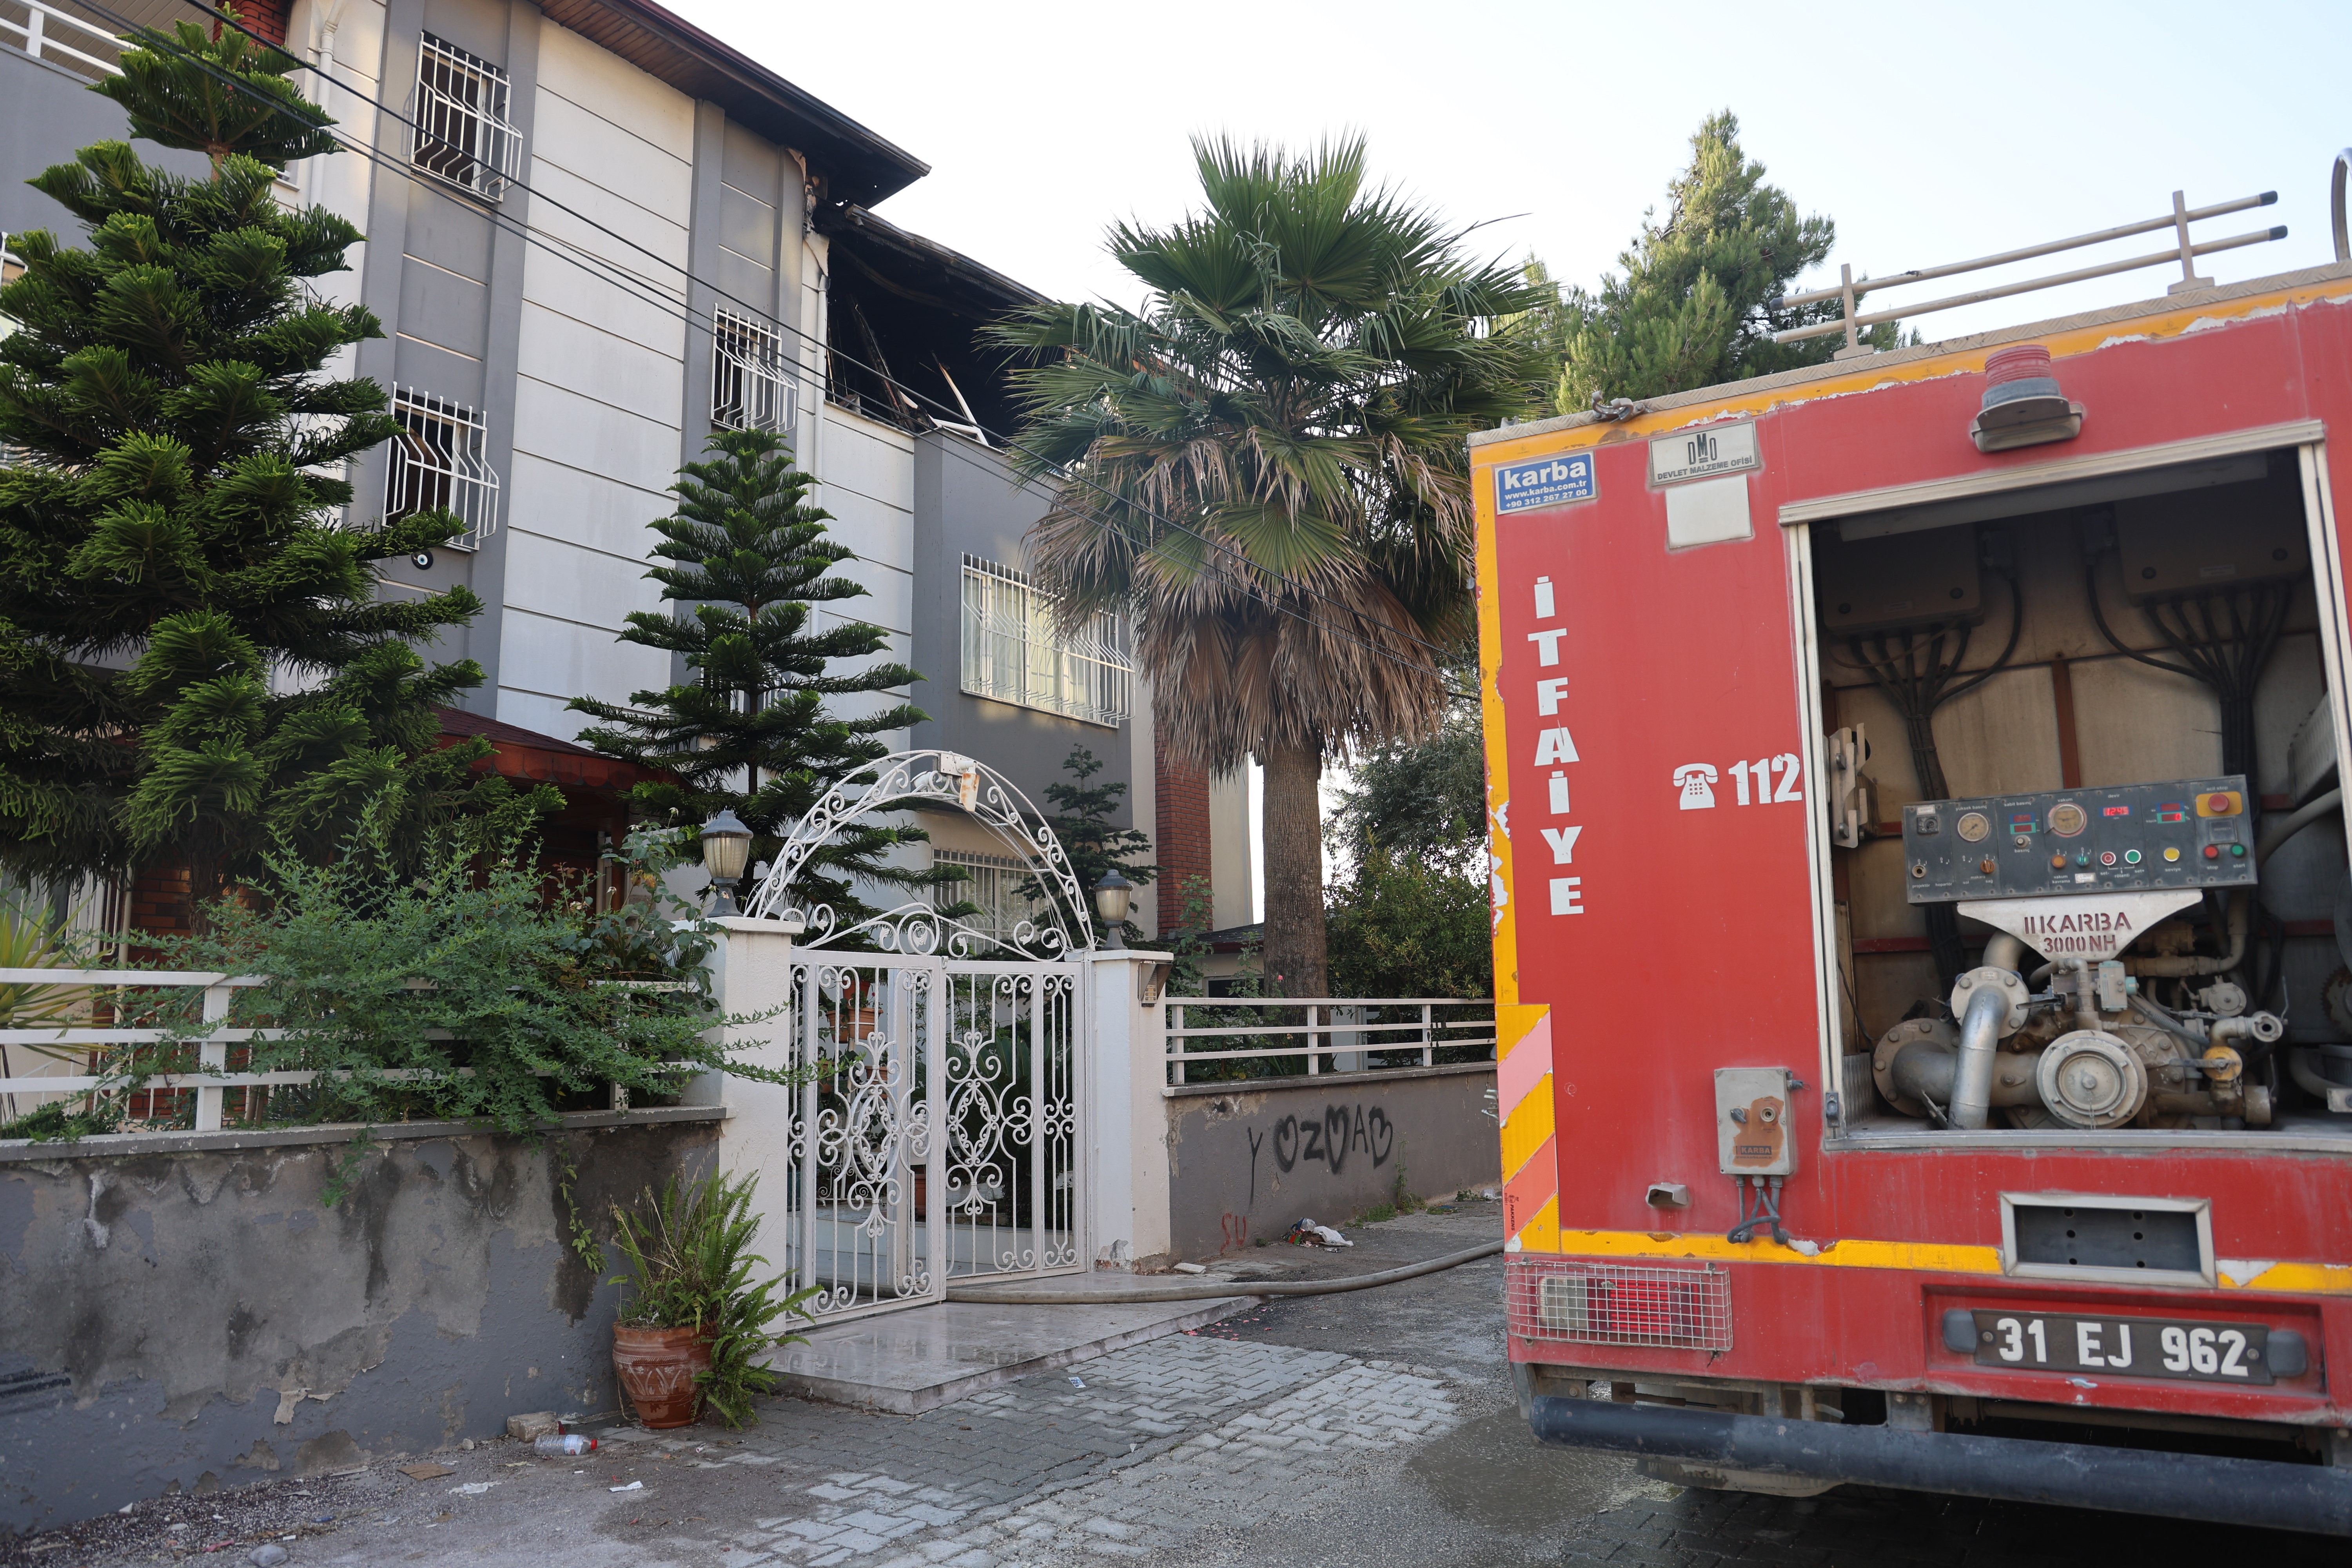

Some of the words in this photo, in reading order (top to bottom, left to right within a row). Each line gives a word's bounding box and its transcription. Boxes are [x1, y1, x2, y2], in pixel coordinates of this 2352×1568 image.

[1688, 433, 1717, 465] DMO
[1504, 461, 1586, 490] karba
[1657, 468, 1688, 480] DEVLET
[1690, 461, 1728, 474] MALZEME
[1731, 455, 1752, 466] OFİSİ
[1504, 480, 1587, 500] www.karba.com.tr
[1524, 497, 1541, 505] 312
[1543, 494, 1559, 502] 267
[1528, 575, 1584, 916] İTFAİYE
[1728, 753, 1802, 806] 112
[1996, 1318, 2047, 1363] 31
[2076, 1321, 2132, 1368] EJ
[2160, 1327, 2249, 1377] 962
